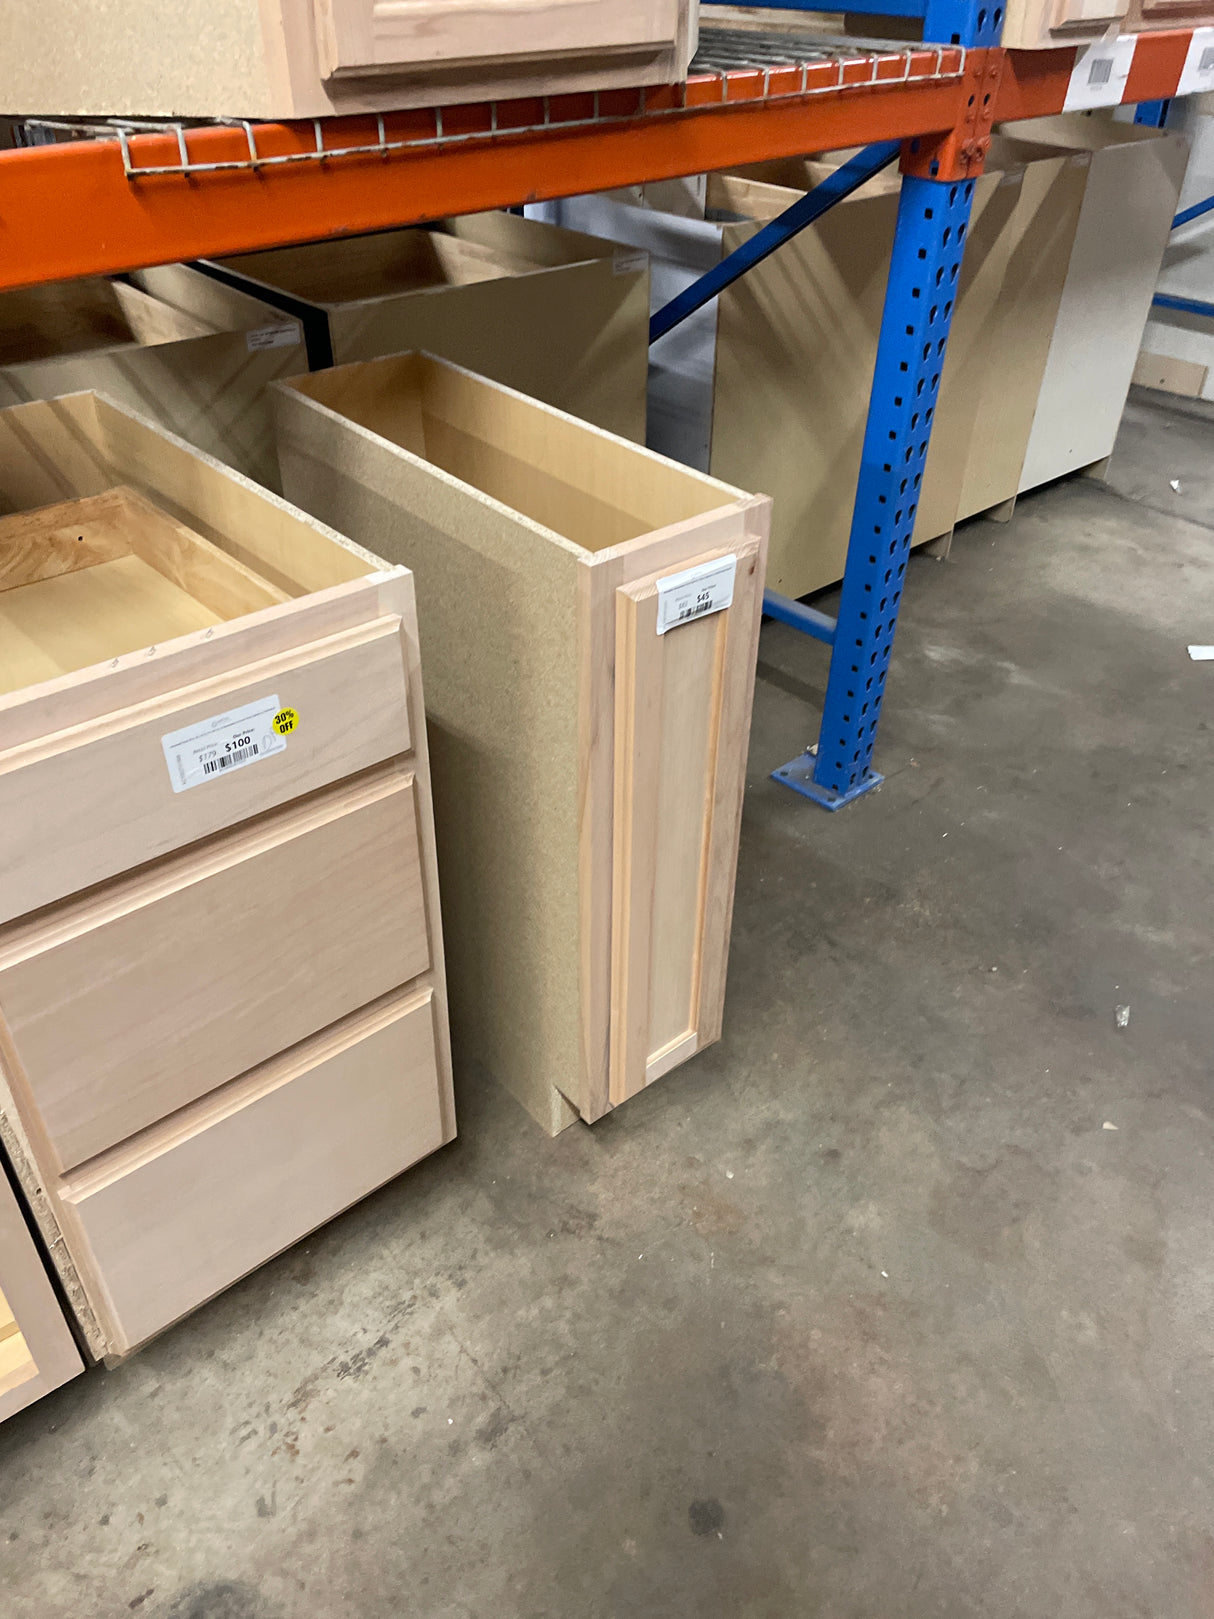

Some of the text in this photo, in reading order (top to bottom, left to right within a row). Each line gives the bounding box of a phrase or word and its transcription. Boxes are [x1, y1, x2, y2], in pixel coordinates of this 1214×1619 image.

[696, 591, 710, 604] $45
[274, 710, 295, 725] 30%
[279, 721, 294, 734] OFF
[224, 736, 251, 752] $100
